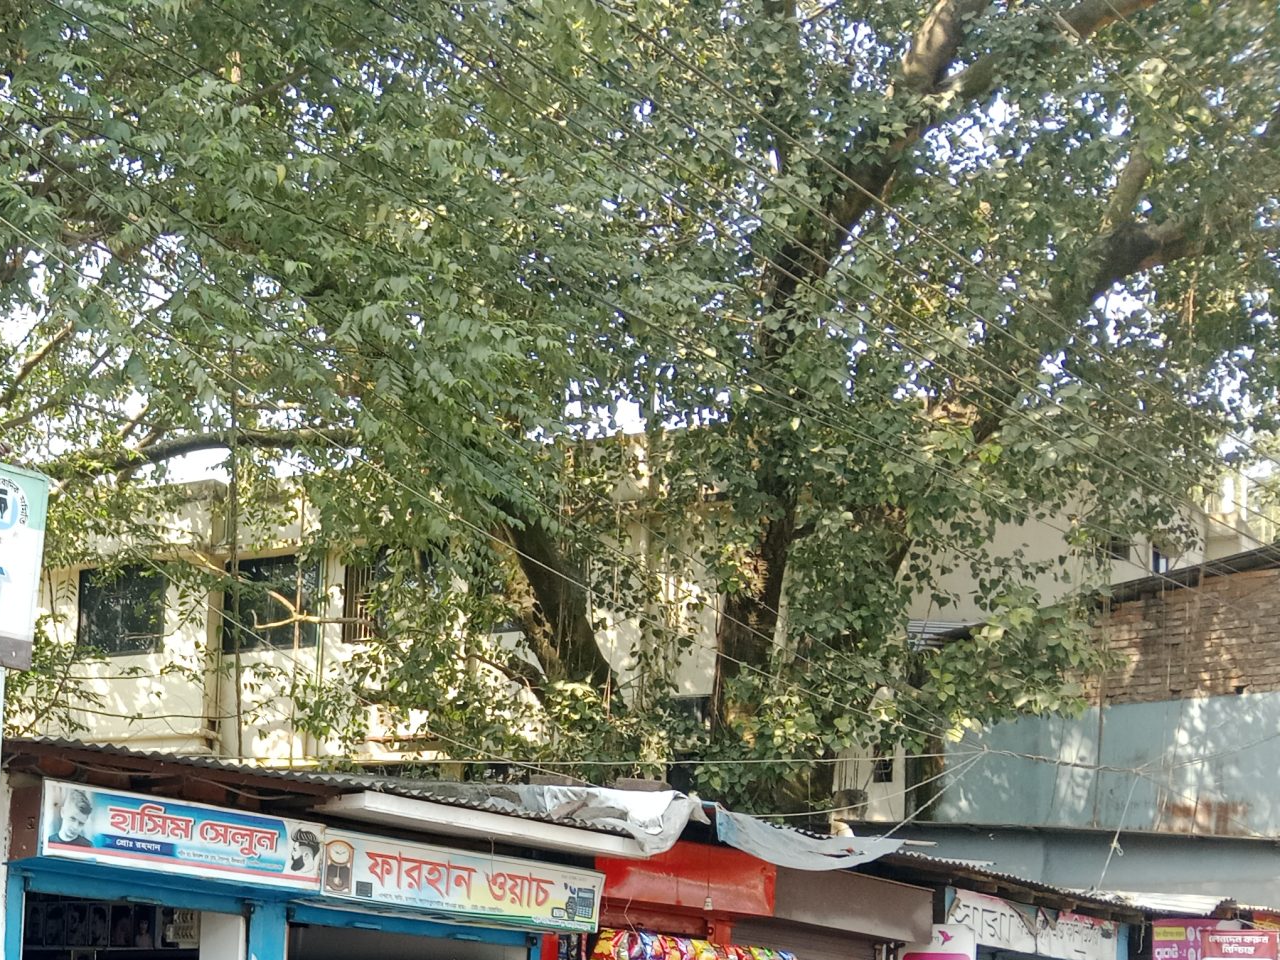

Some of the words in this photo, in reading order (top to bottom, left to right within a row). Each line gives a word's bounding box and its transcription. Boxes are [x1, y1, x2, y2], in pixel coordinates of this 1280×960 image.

[109, 804, 193, 840] হাসিম
[199, 821, 279, 858] সেলুন
[366, 850, 477, 900] ফারহান
[484, 870, 555, 908] ওয়াচ
